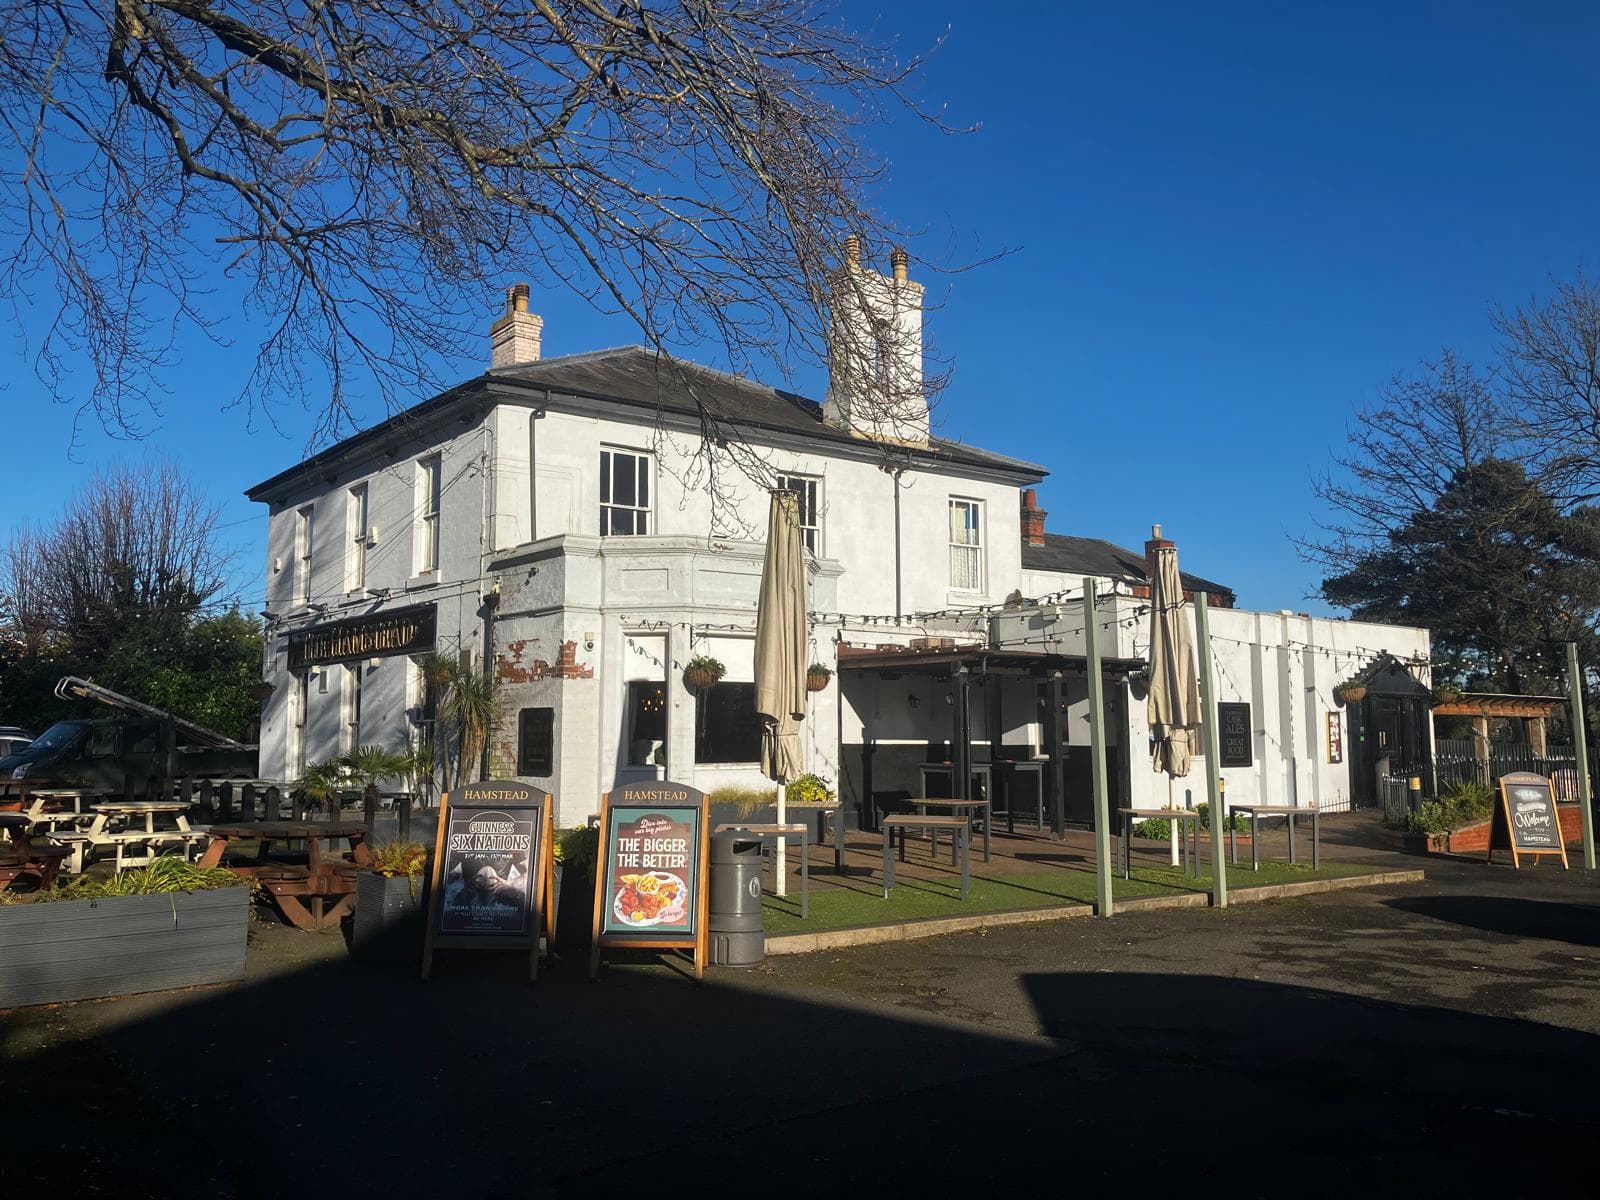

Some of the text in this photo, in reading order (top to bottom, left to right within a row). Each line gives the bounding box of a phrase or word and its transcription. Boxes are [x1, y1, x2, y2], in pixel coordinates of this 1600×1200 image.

[304, 621, 416, 660] THE HAMSTEAD
[464, 790, 528, 800] HAMSTEAD
[624, 790, 688, 800] HAMSTEAD
[1515, 812, 1550, 828] Welcome
[469, 822, 515, 834] GUINNESS
[451, 834, 530, 851] SIX NATIONS
[619, 838, 688, 853] THE BIGGER.
[618, 854, 687, 868] THE BETTER.
